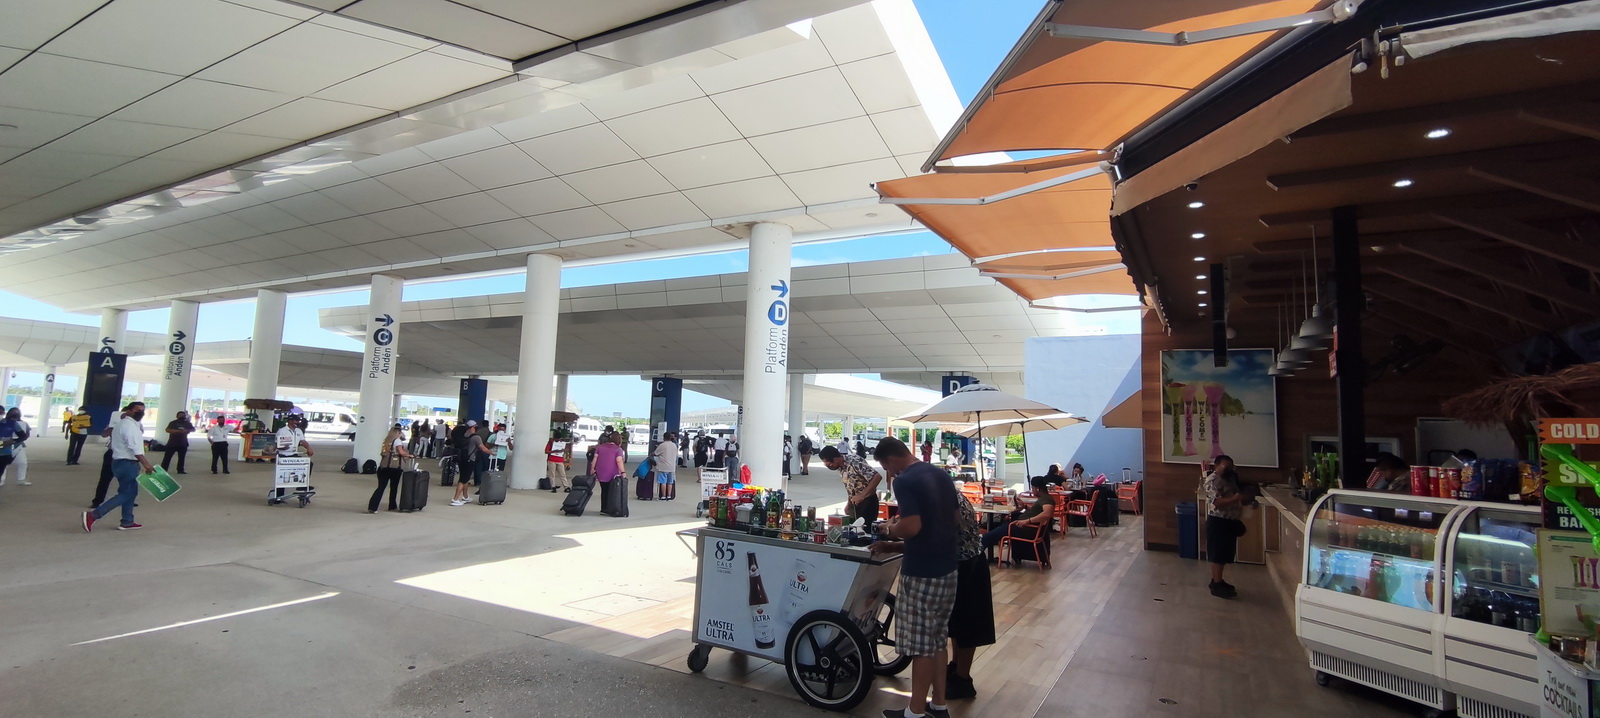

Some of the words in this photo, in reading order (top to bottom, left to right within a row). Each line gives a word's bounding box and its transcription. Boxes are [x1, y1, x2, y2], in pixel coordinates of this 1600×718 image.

[774, 304, 786, 321] D
[378, 331, 389, 343] C
[172, 343, 182, 353] B
[765, 327, 778, 373] Platform
[779, 329, 787, 367] Andén
[101, 356, 114, 368] A
[165, 355, 175, 380] Platform
[174, 356, 184, 377] Andén
[369, 346, 381, 379] Platform
[381, 347, 391, 375] Andén
[463, 381, 469, 390] B
[656, 380, 664, 392] C
[950, 380, 961, 394] D
[1550, 423, 1599, 439] COLD
[715, 541, 735, 561] 85
[789, 579, 809, 593] ULTRA
[706, 618, 734, 631] AMSTEL
[752, 614, 771, 622] ULTRA
[706, 626, 734, 642] ULTRA
